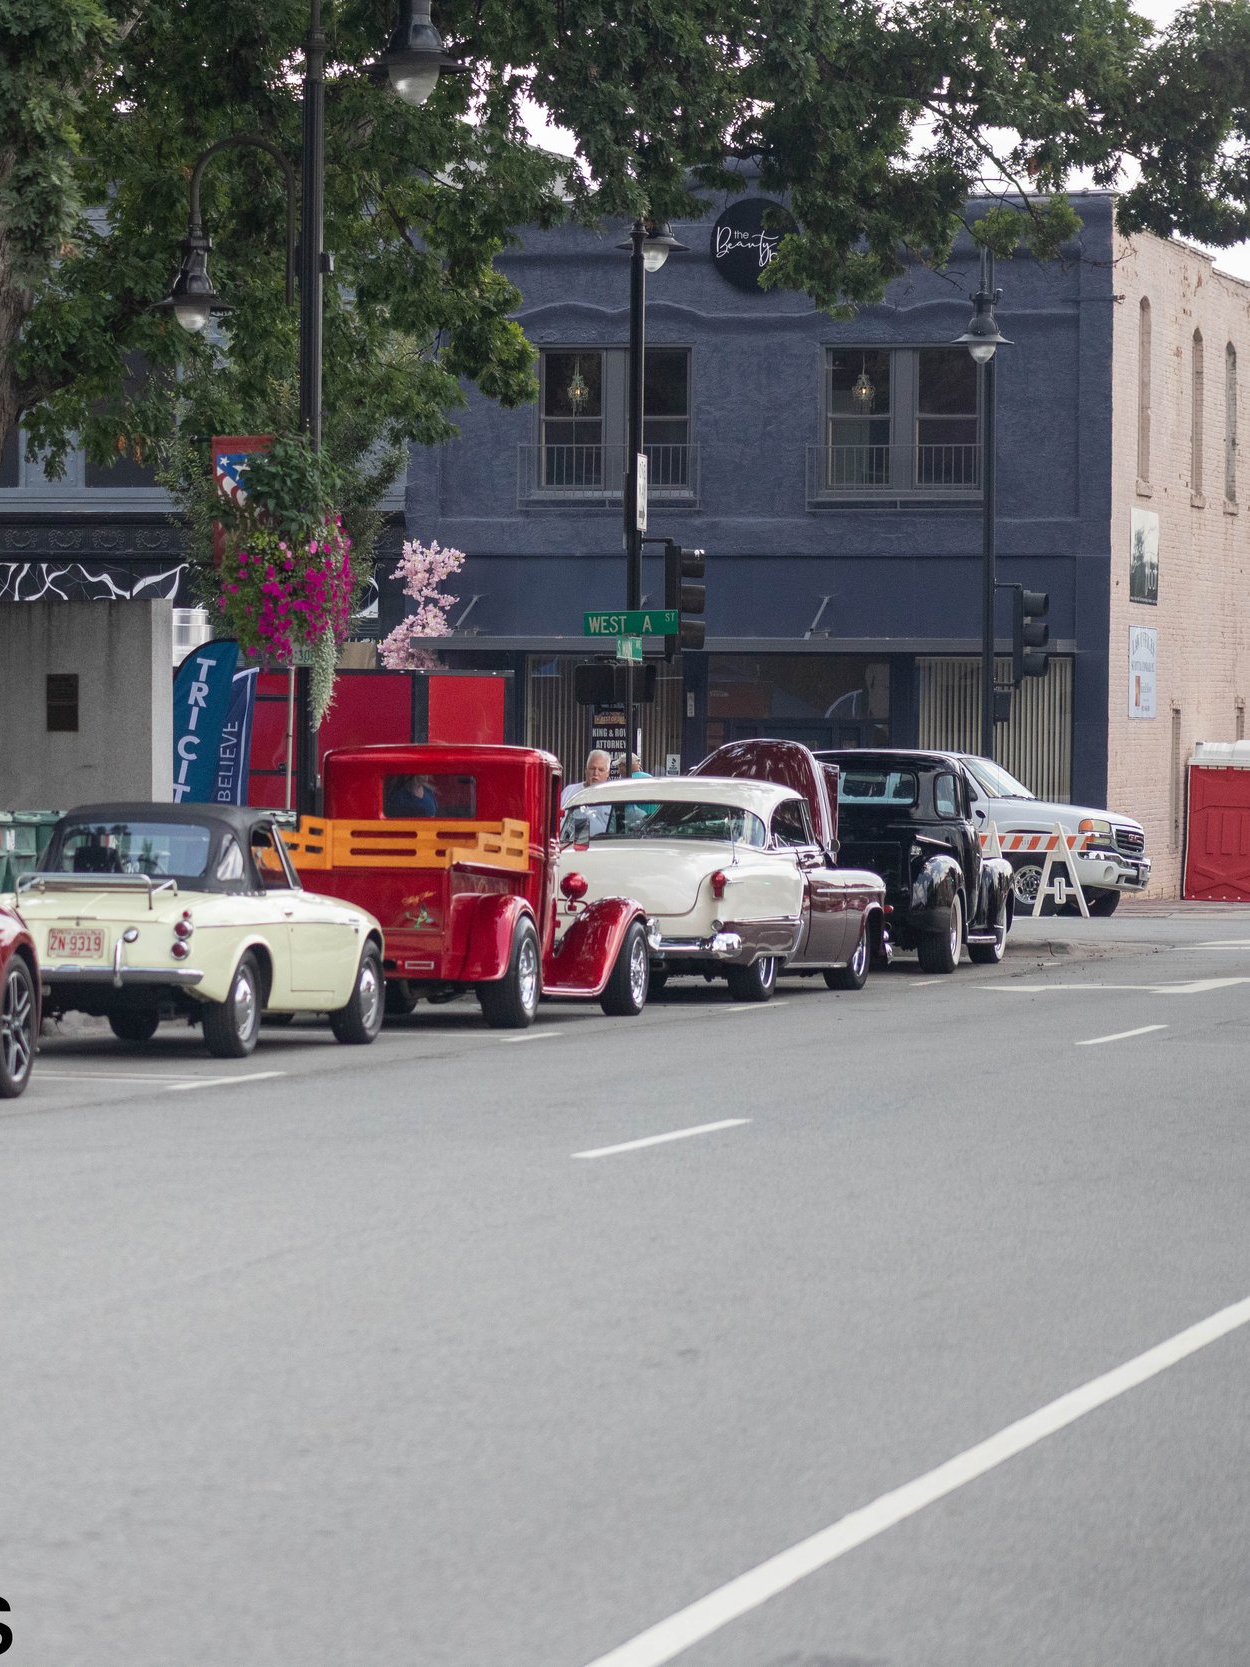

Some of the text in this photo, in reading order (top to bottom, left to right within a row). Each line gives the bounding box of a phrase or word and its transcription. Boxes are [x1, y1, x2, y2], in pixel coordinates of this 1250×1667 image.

[734, 231, 749, 239] the
[716, 226, 779, 267] Beauty
[589, 613, 675, 633] WEST A ST
[592, 728, 607, 738] KING
[608, 728, 614, 737] &
[596, 740, 627, 749] ATTORNEY
[217, 721, 238, 802] BELIEVE
